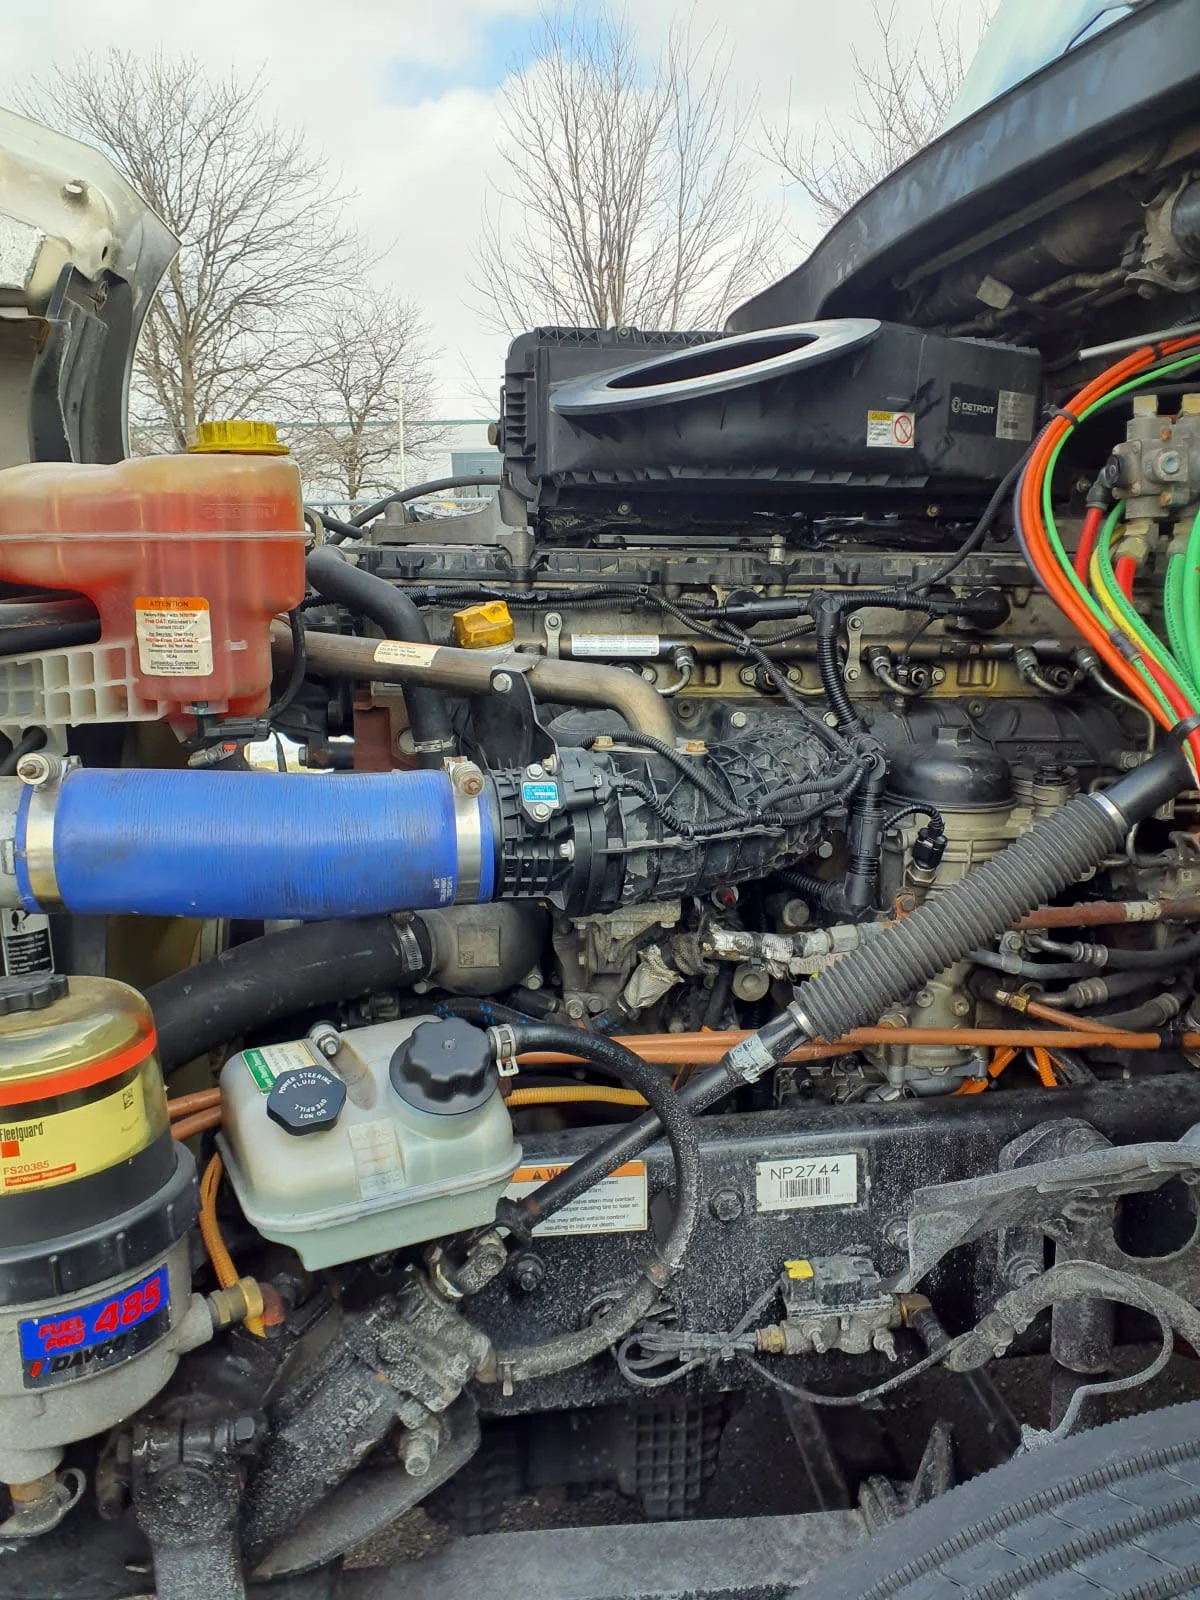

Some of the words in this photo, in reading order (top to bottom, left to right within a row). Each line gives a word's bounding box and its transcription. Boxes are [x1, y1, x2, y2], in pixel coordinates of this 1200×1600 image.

[962, 402, 995, 414] DETROIT
[279, 1076, 297, 1094] POWER
[299, 1073, 332, 1084] STEERING
[293, 1080, 316, 1088] FLUID
[295, 1099, 327, 1112] OVERFILL
[316, 1108, 327, 1117] DO
[0, 1122, 43, 1141] Fleetguard
[3, 1161, 50, 1175] FS20385
[770, 1163, 841, 1180] NP2744
[544, 1224, 568, 1232] resulting
[576, 1223, 591, 1231] injury
[94, 1277, 161, 1332] 485
[38, 1316, 86, 1339] FUEL
[45, 1330, 85, 1351] PRO
